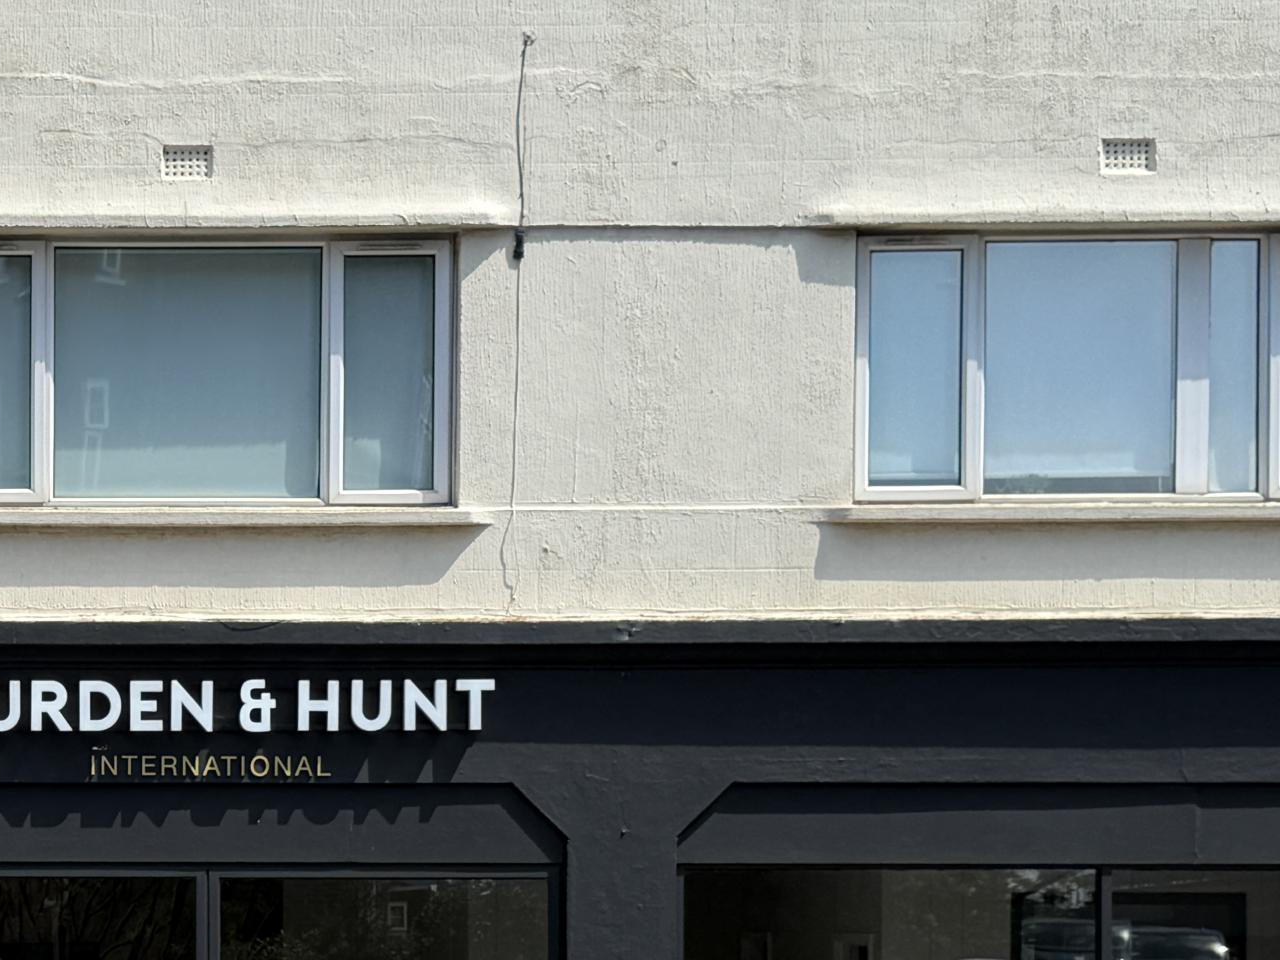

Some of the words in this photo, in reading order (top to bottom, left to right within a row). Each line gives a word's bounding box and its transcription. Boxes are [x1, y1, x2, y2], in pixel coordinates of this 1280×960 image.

[239, 678, 276, 732] &
[297, 678, 496, 732] HUNT
[90, 754, 332, 777] INTERNATIONAL
